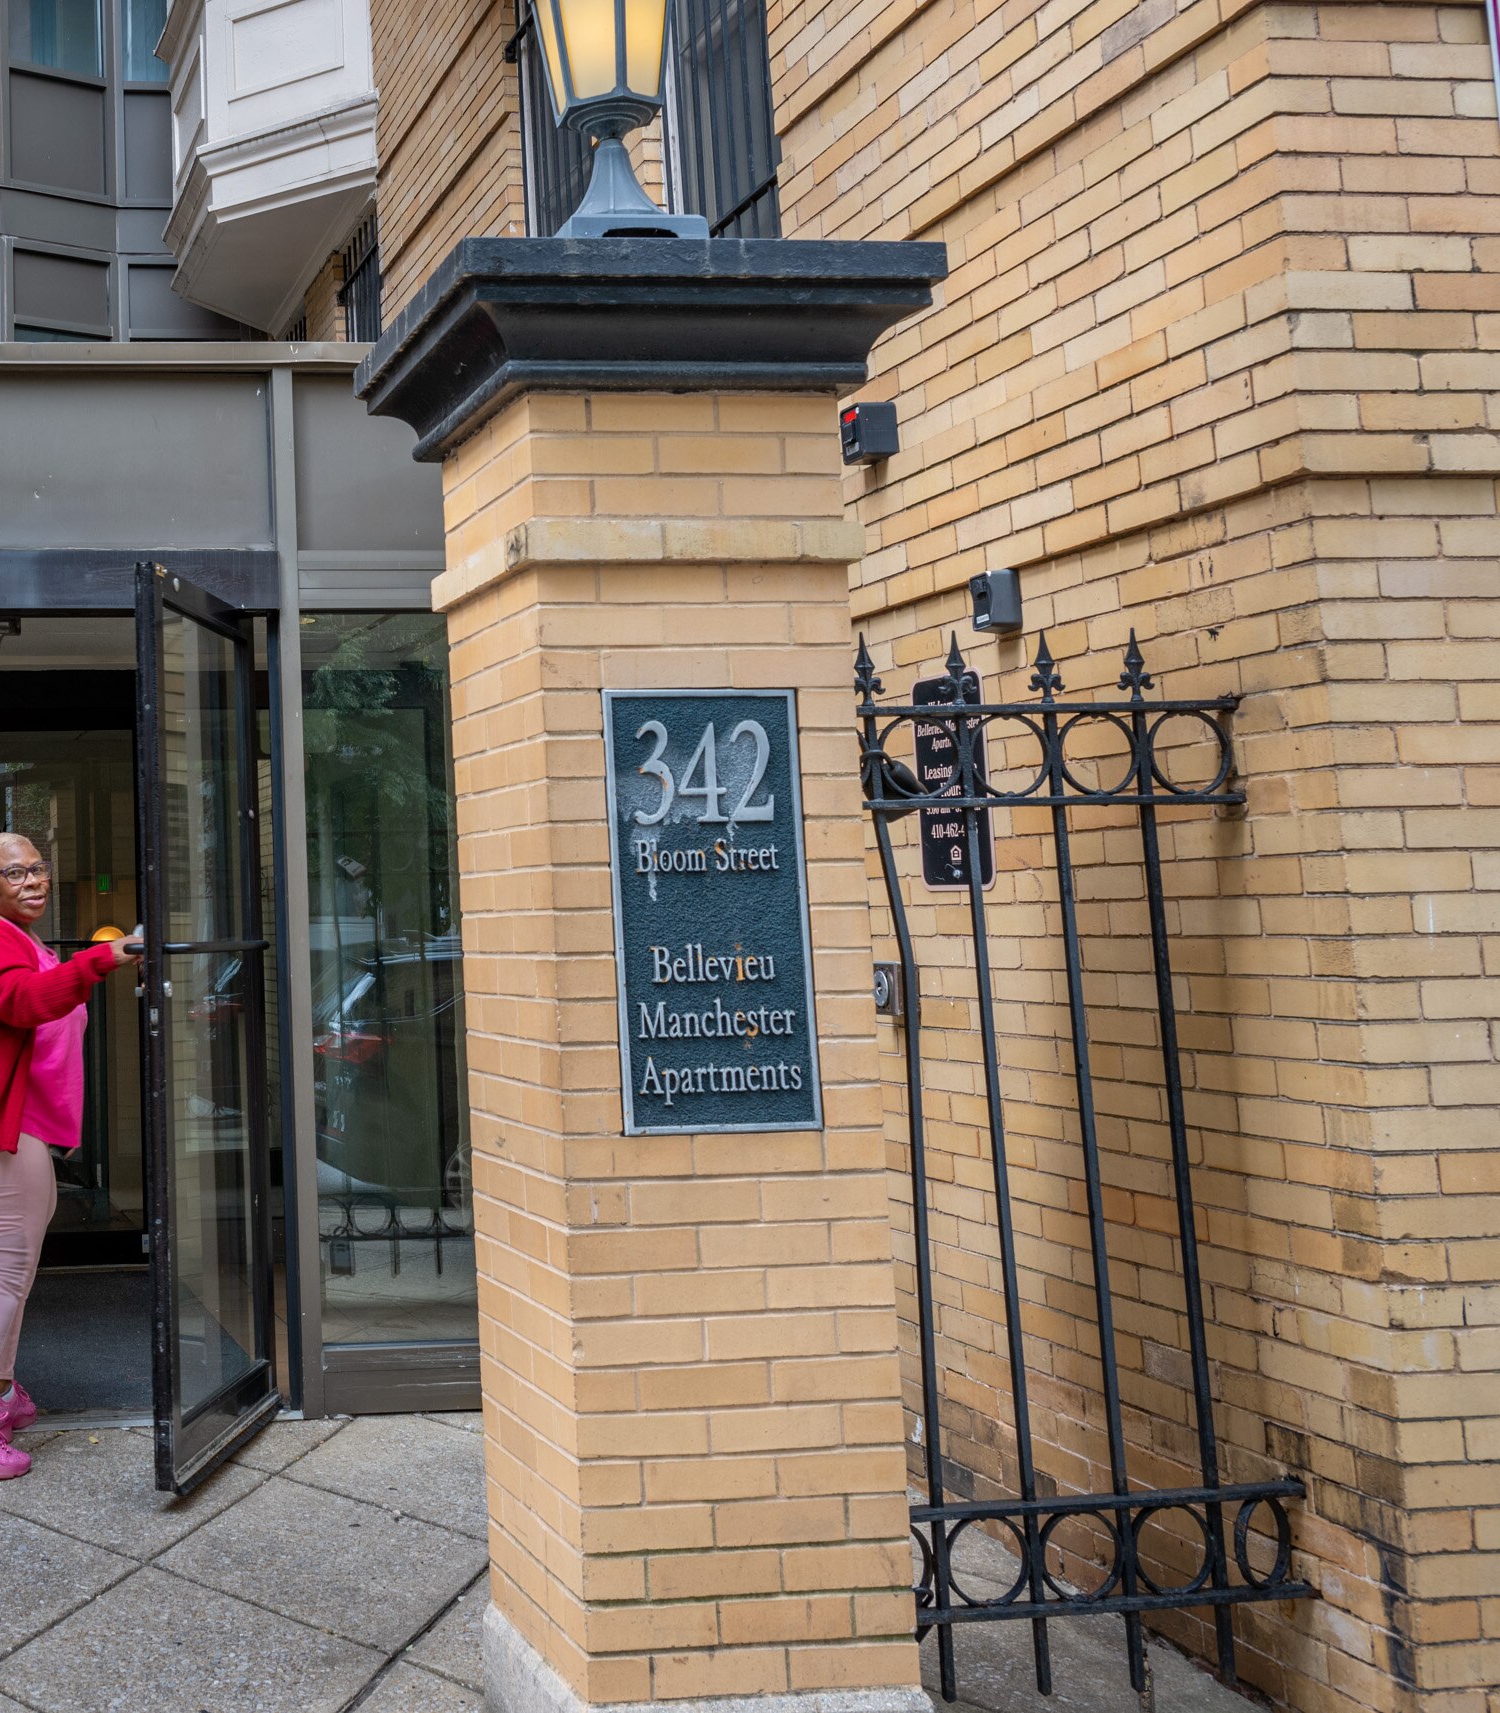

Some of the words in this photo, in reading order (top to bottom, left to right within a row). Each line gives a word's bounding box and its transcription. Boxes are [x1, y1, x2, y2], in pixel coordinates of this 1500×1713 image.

[634, 719, 775, 825] 342
[924, 763, 953, 780] Leasing
[635, 839, 707, 873] Bloom
[715, 840, 779, 872] Street
[650, 943, 776, 984] Bellevieu
[637, 998, 796, 1039] Manchester
[640, 1056, 802, 1106] Apartments
